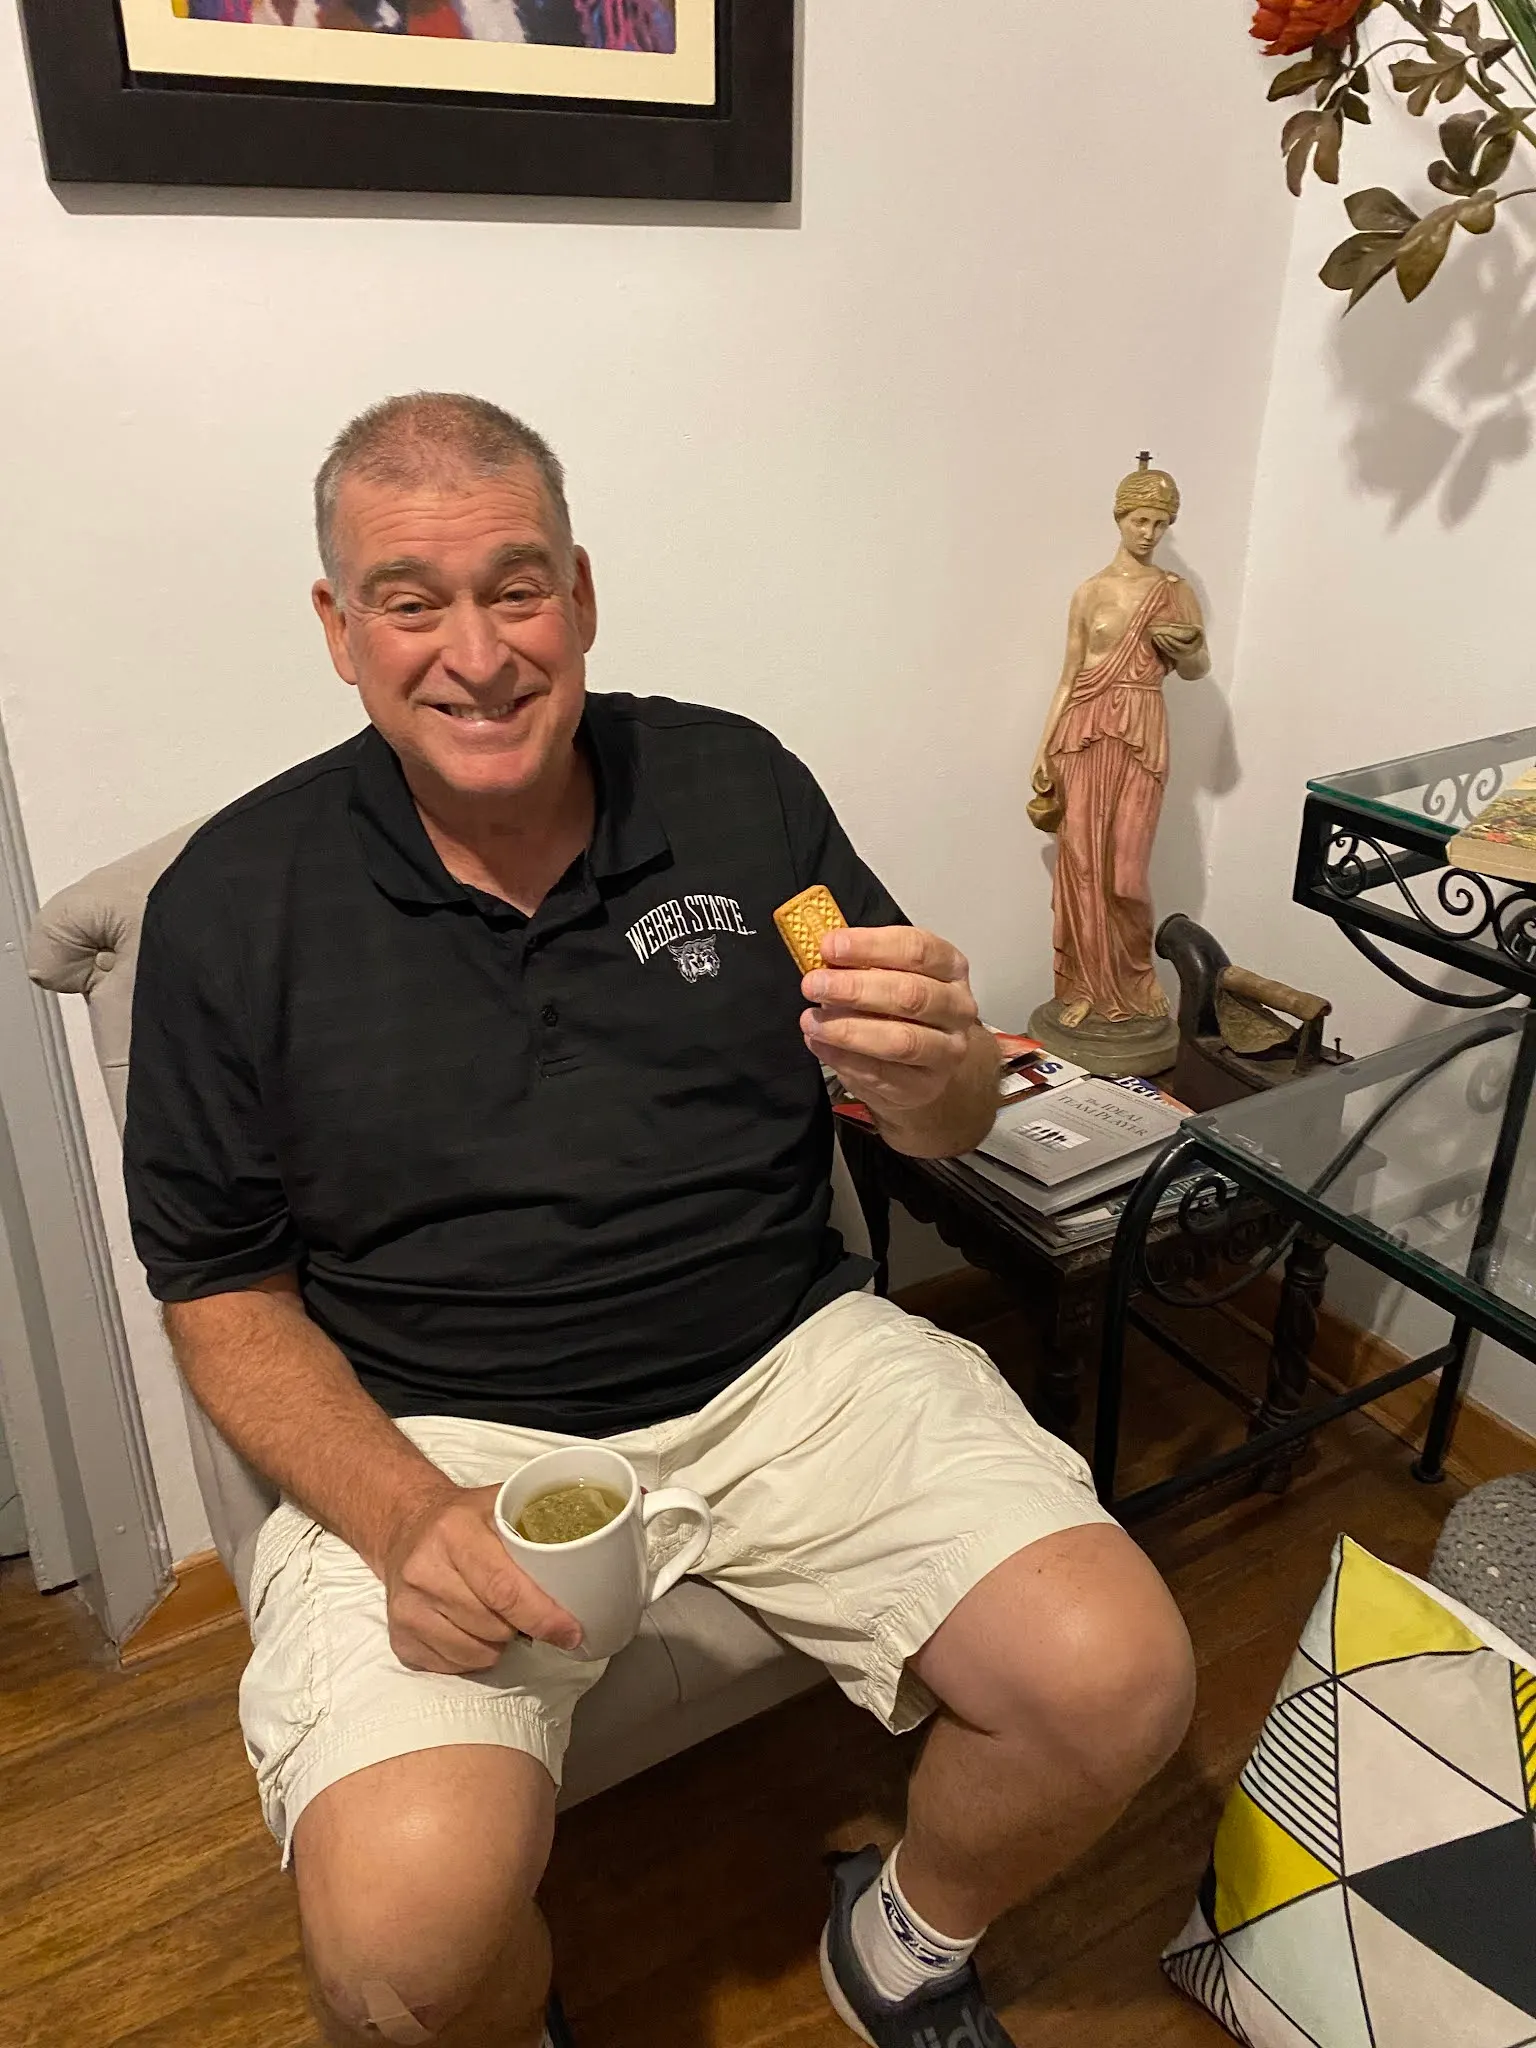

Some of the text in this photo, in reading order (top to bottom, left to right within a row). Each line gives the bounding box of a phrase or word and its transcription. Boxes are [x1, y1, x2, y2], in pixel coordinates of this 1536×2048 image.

[625, 894, 757, 964] WEBER STATE
[1059, 1096, 1095, 1114] TEAM
[1095, 1111, 1148, 1136] PLAYER
[1100, 1103, 1143, 1122] IDEAL
